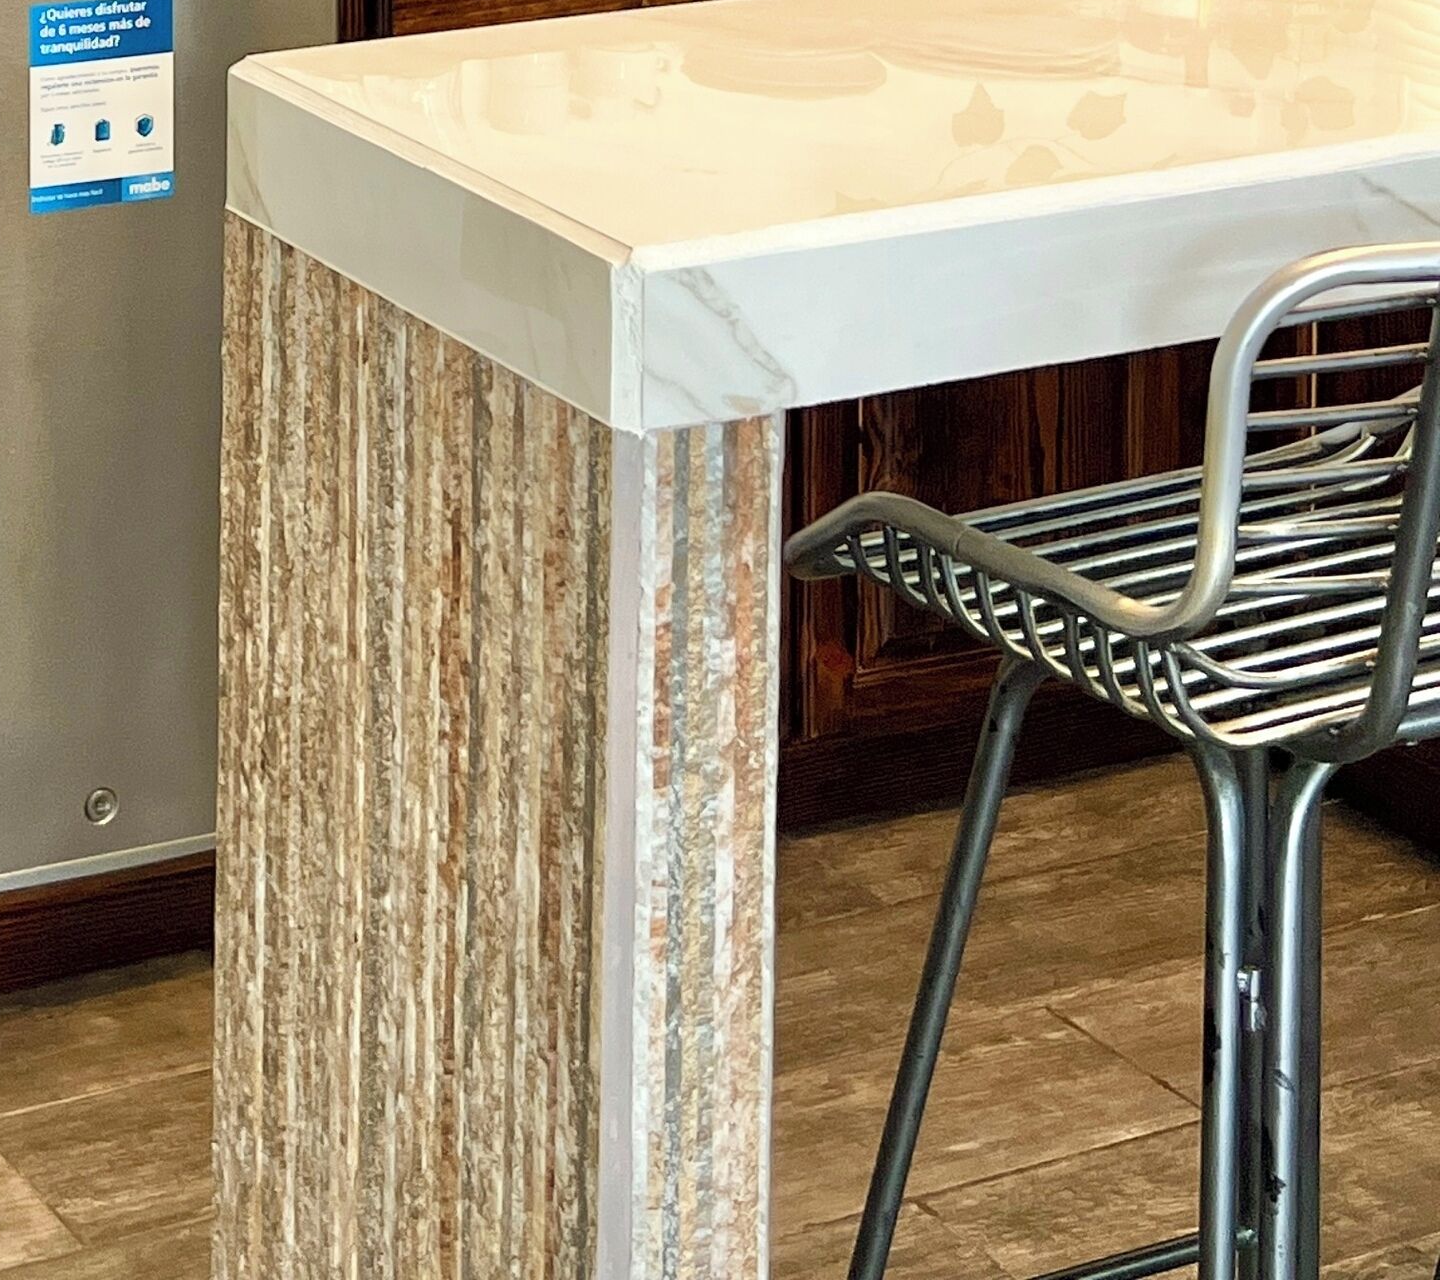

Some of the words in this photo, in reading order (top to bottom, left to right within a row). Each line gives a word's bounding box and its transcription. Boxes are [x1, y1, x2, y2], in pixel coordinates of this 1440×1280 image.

[39, 7, 93, 25] ¿Quieres
[94, 1, 147, 16] disfrutar
[39, 25, 56, 38] de
[58, 25, 67, 36] 6
[69, 22, 106, 34] meses
[108, 17, 133, 31] más
[134, 15, 151, 28] de
[39, 34, 121, 55] tranquilidad?
[128, 177, 171, 195] mabe
